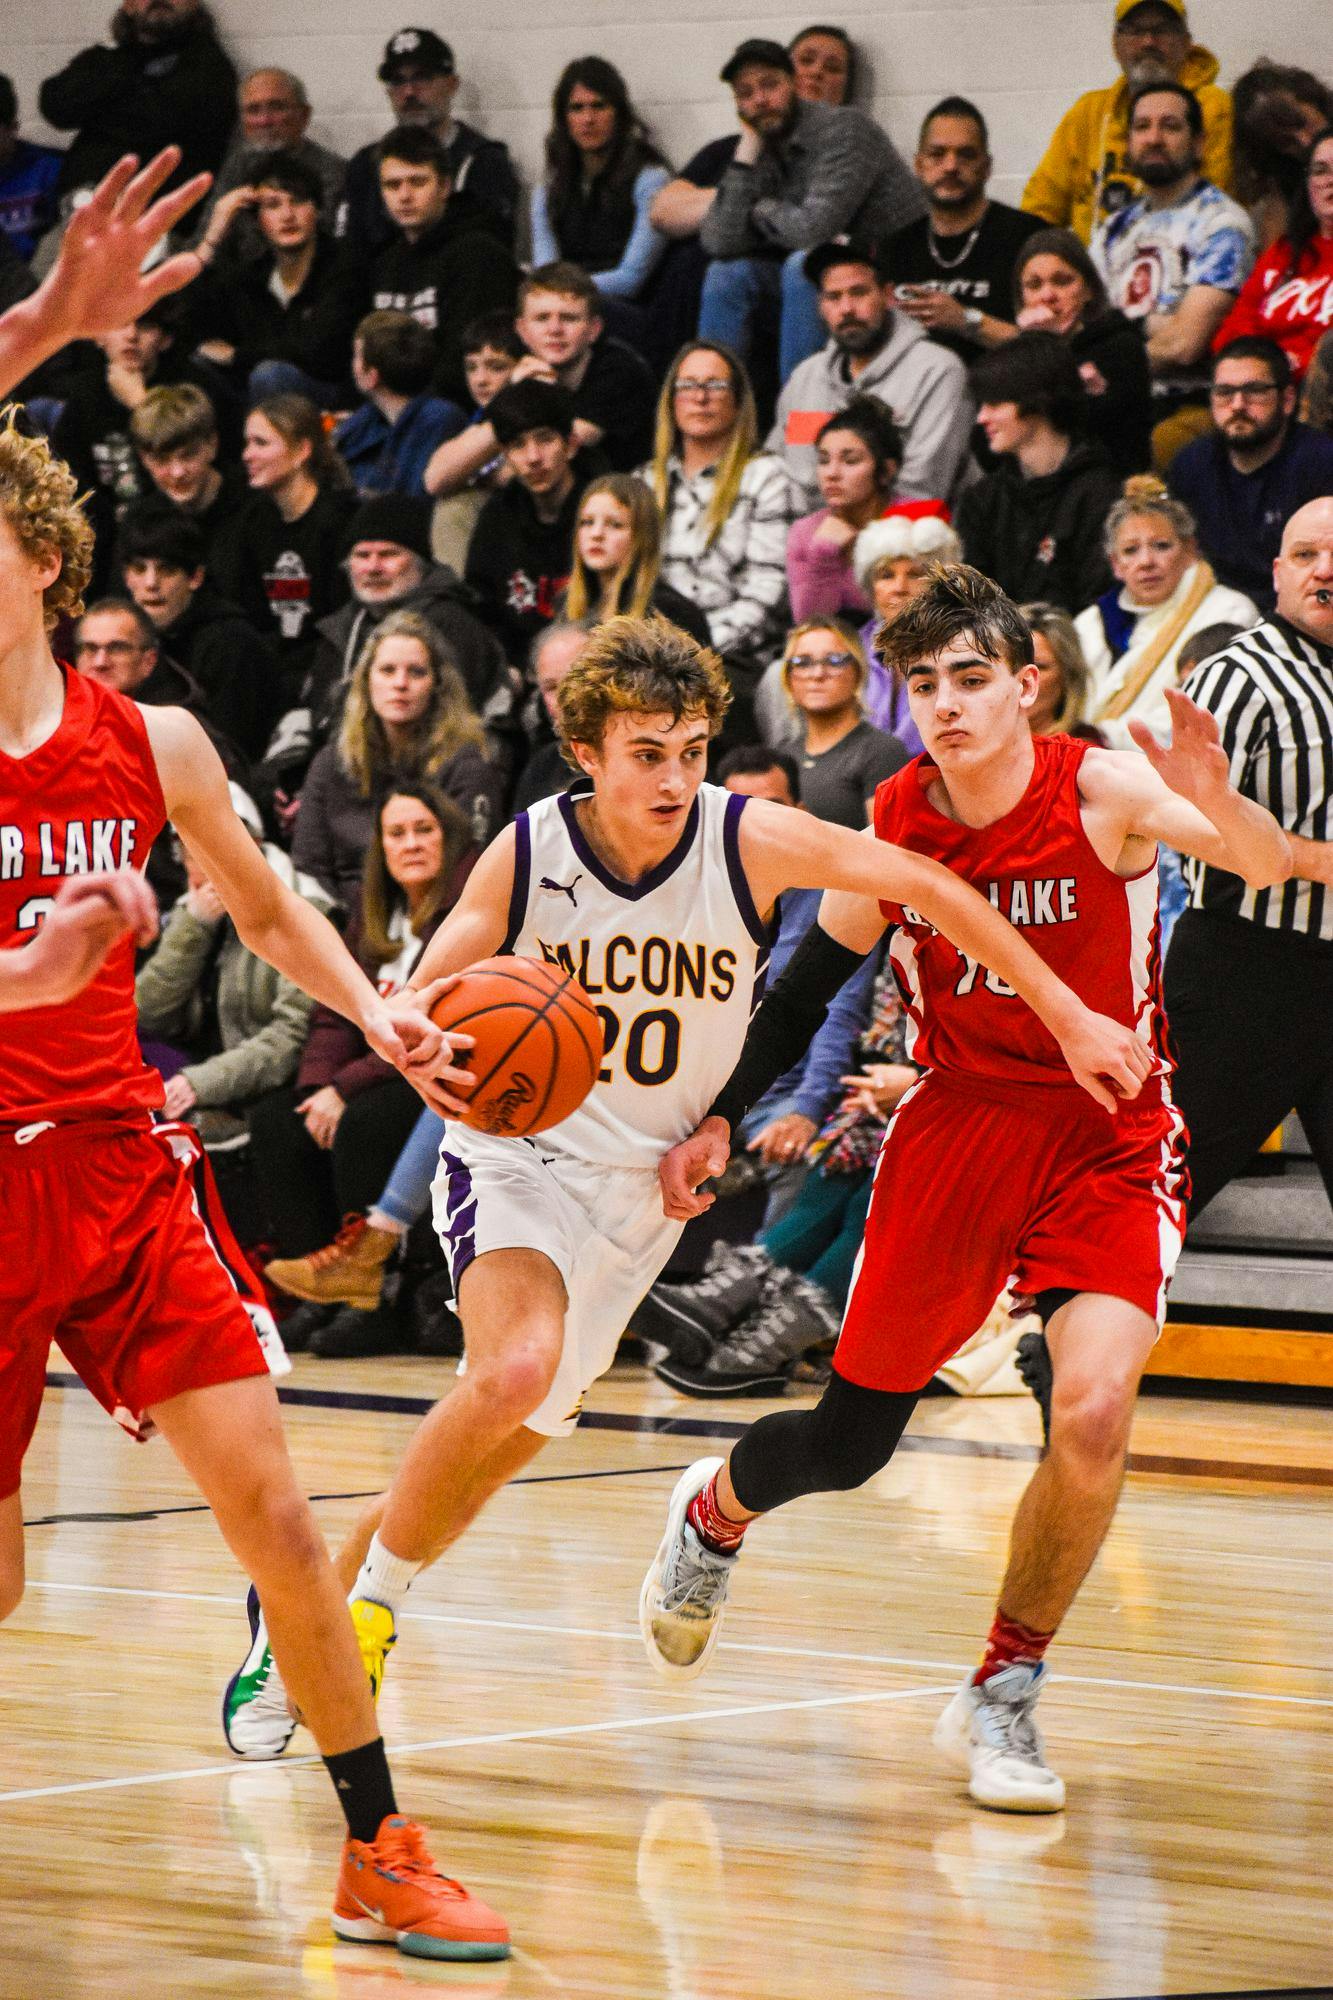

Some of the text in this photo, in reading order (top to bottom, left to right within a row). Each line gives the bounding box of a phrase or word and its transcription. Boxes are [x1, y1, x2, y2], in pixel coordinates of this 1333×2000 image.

[0, 818, 137, 881] R LAKE
[594, 1003, 682, 1088] 20
